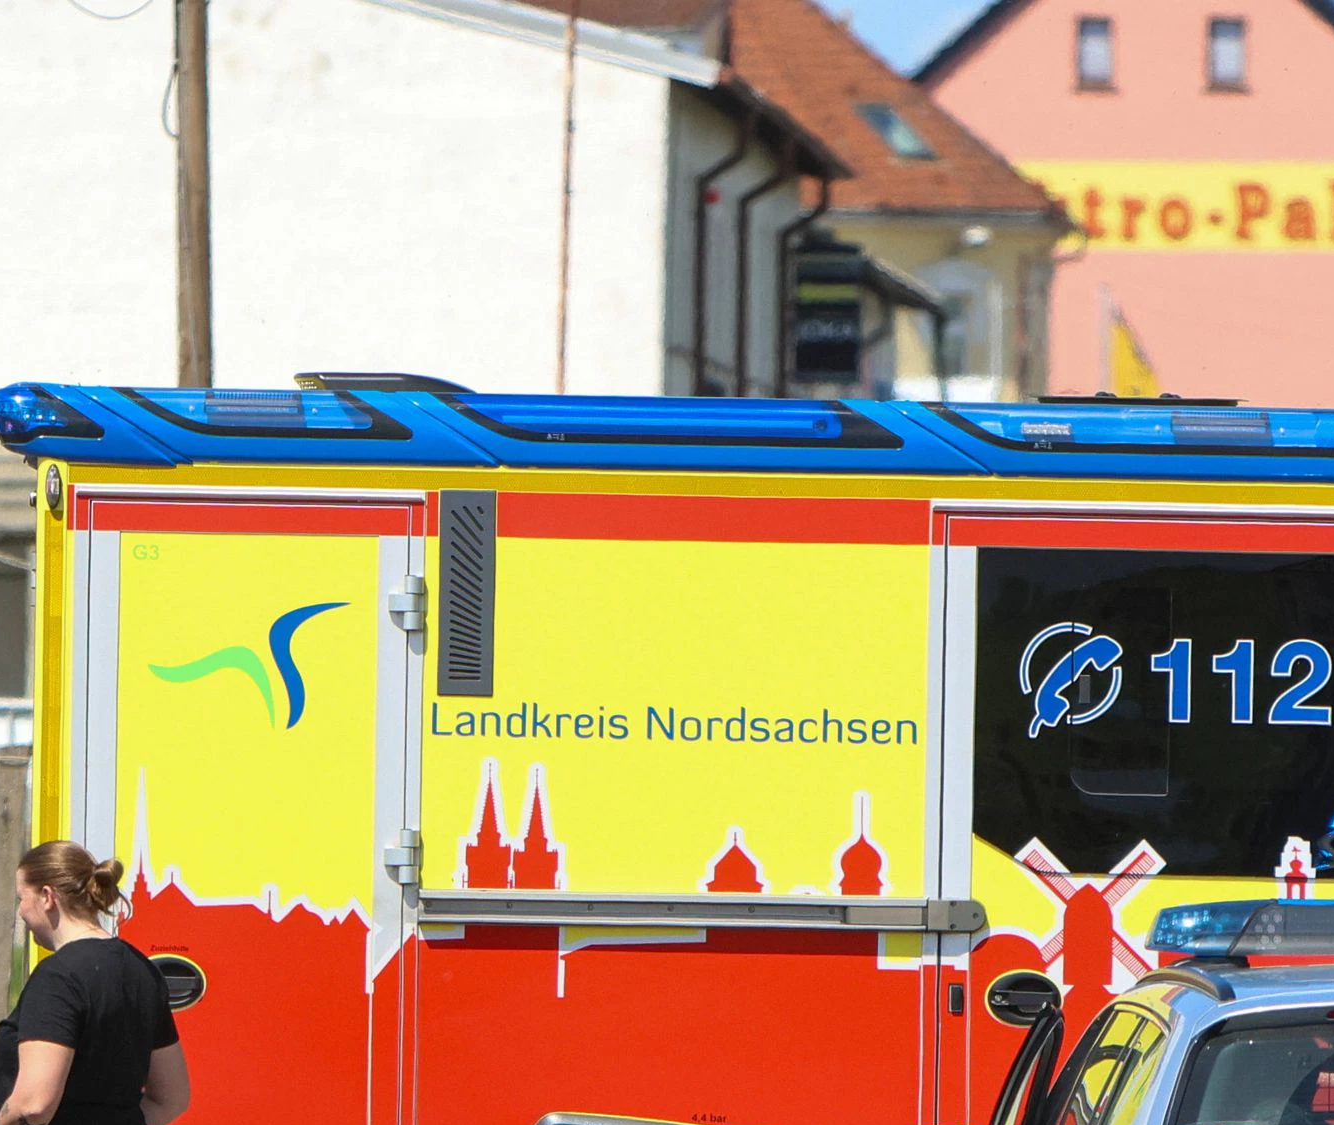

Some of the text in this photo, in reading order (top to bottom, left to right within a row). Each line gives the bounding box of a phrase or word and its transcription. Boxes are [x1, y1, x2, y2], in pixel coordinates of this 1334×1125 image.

[131, 544, 159, 560] G3
[1150, 638, 1333, 726] 112
[431, 702, 918, 744] Landkreis Nordsachsen
[709, 1113, 727, 1123] bar
